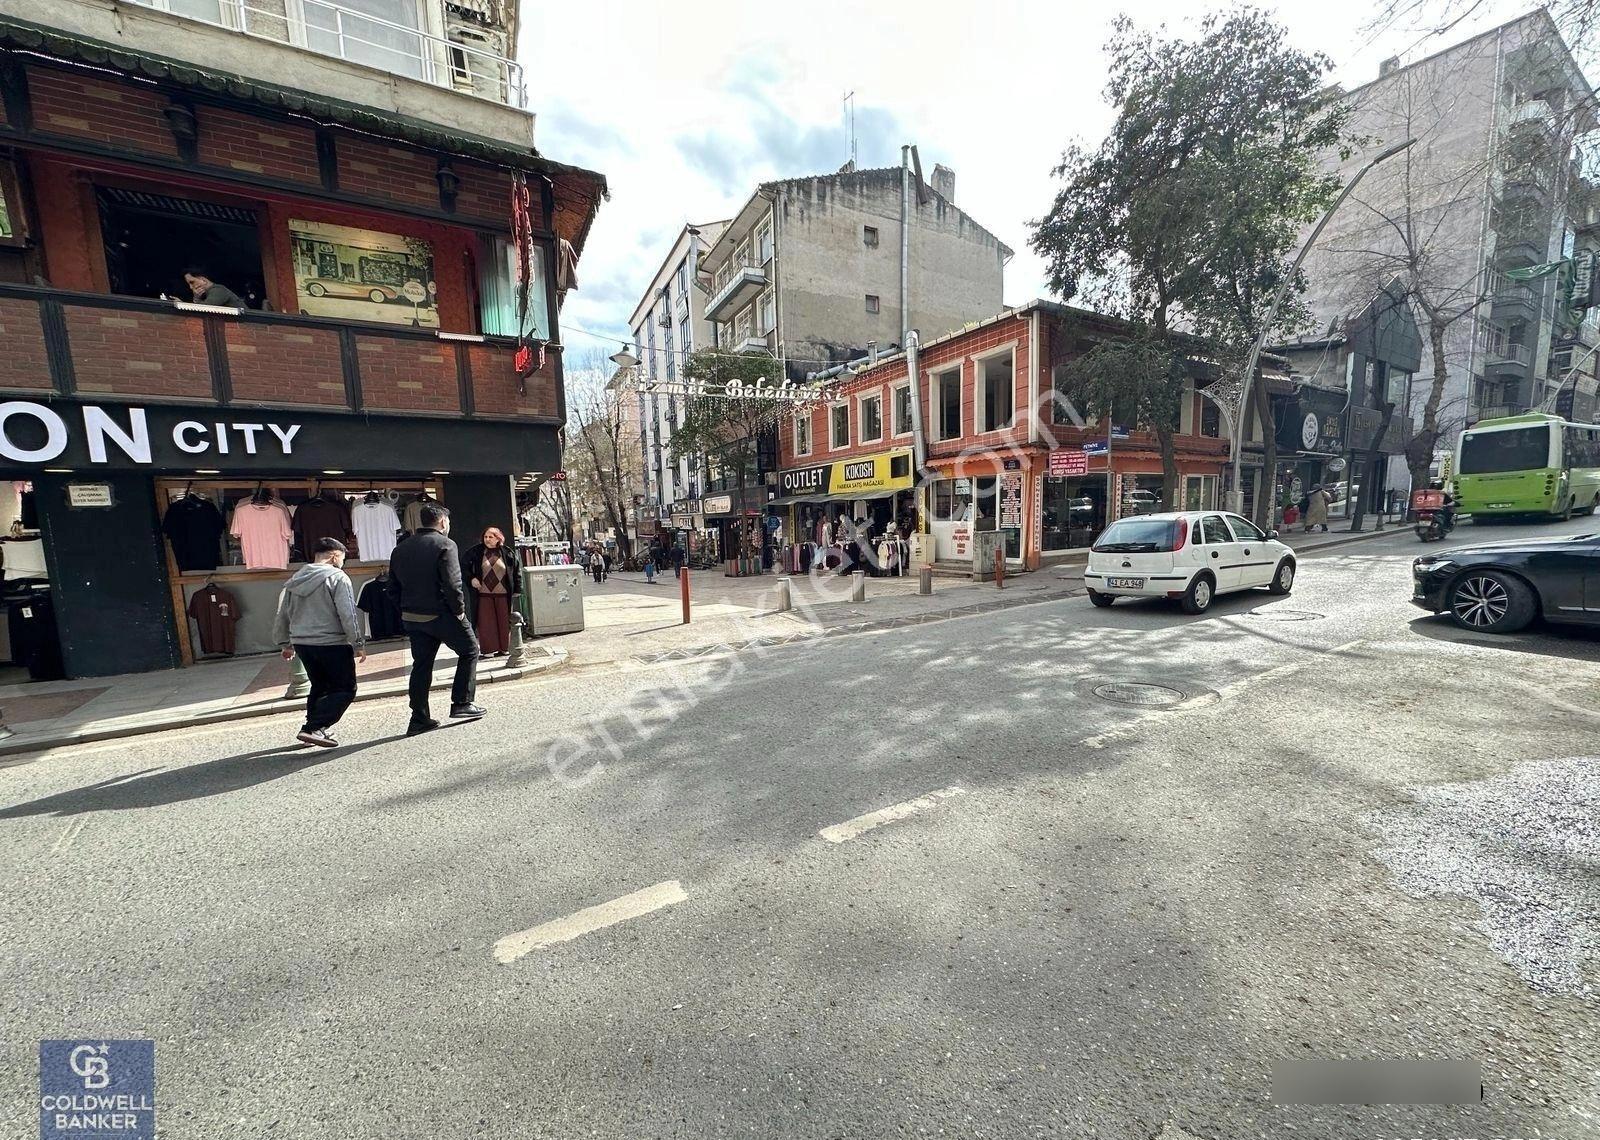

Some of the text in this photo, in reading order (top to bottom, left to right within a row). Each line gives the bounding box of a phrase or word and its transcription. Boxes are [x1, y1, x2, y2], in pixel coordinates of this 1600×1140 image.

[0, 401, 301, 463] ON CITY
[784, 469, 824, 490] OUTLET
[845, 462, 874, 480] KOKOSH
